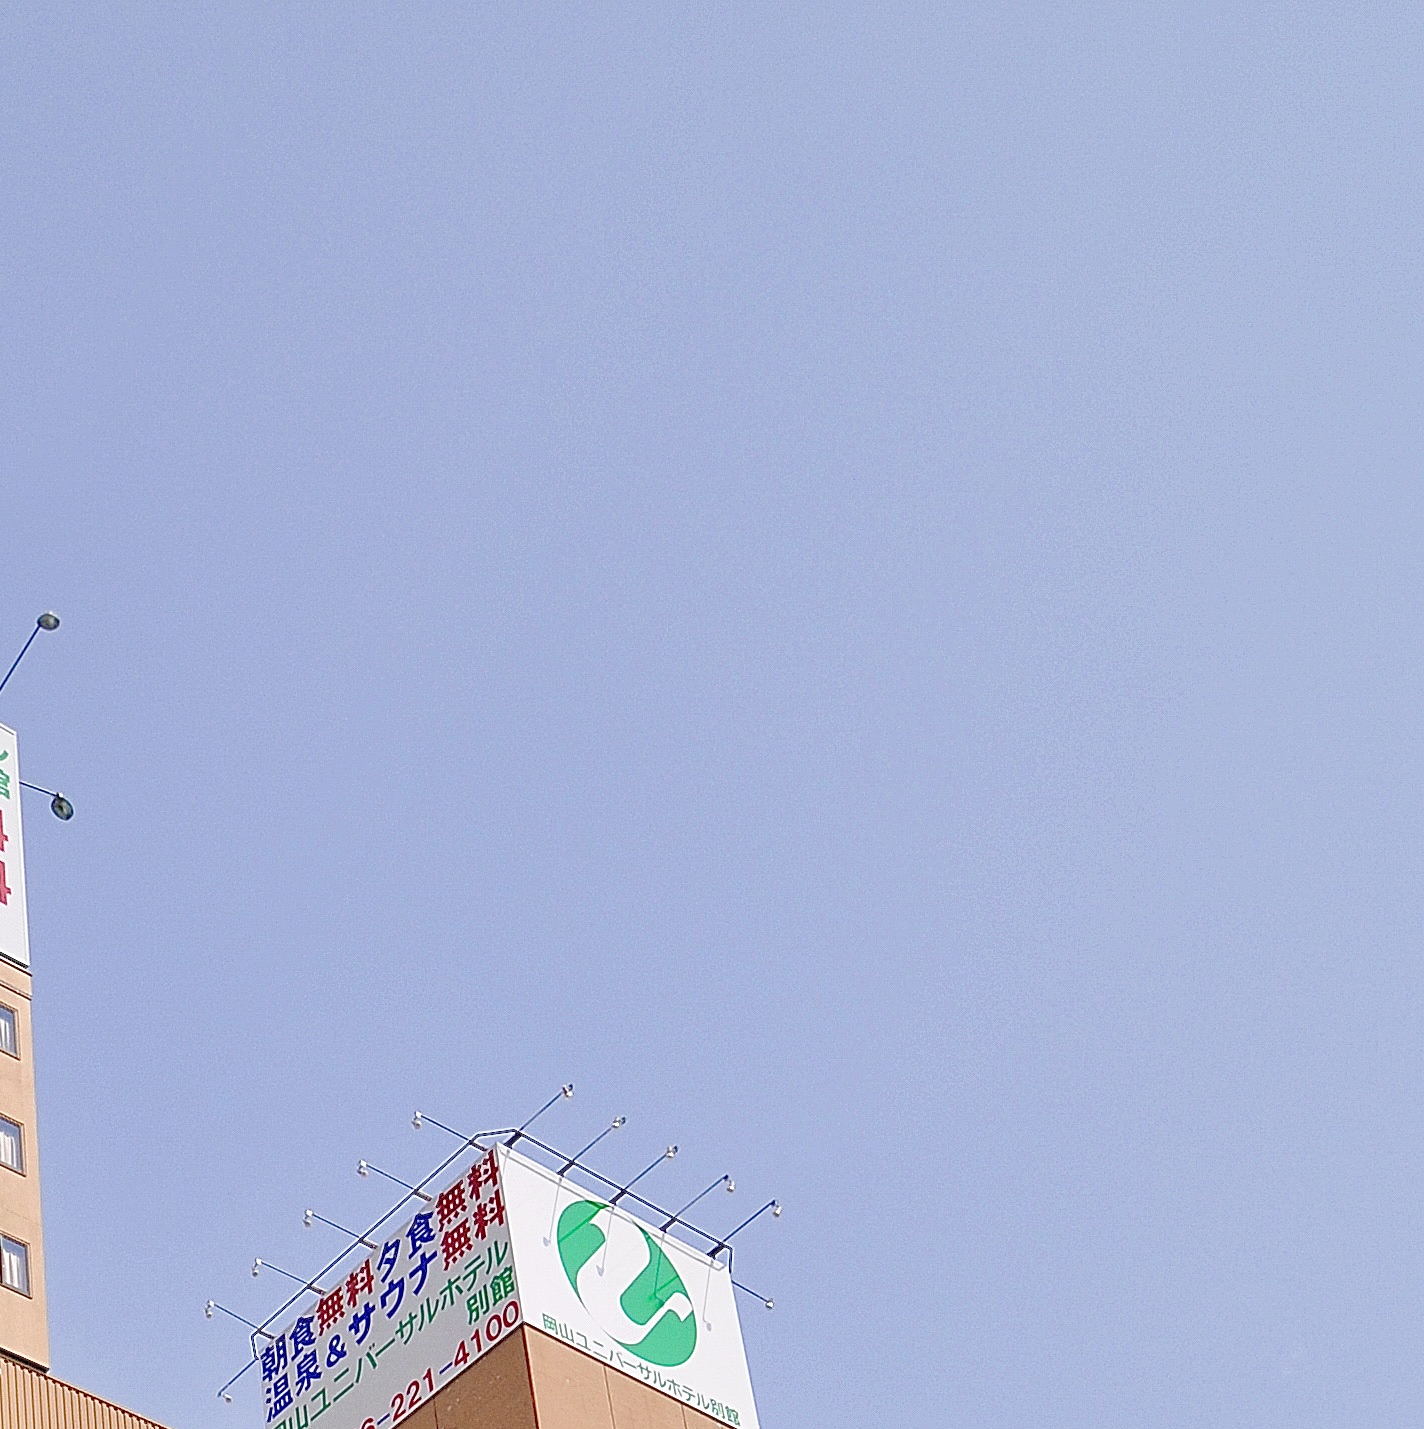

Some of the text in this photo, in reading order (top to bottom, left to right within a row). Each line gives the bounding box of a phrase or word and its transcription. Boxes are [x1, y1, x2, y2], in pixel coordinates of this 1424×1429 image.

[467, 1265, 517, 1327] 別館
[542, 1313, 741, 1428] 岡山ユニバーサルホテル別館
